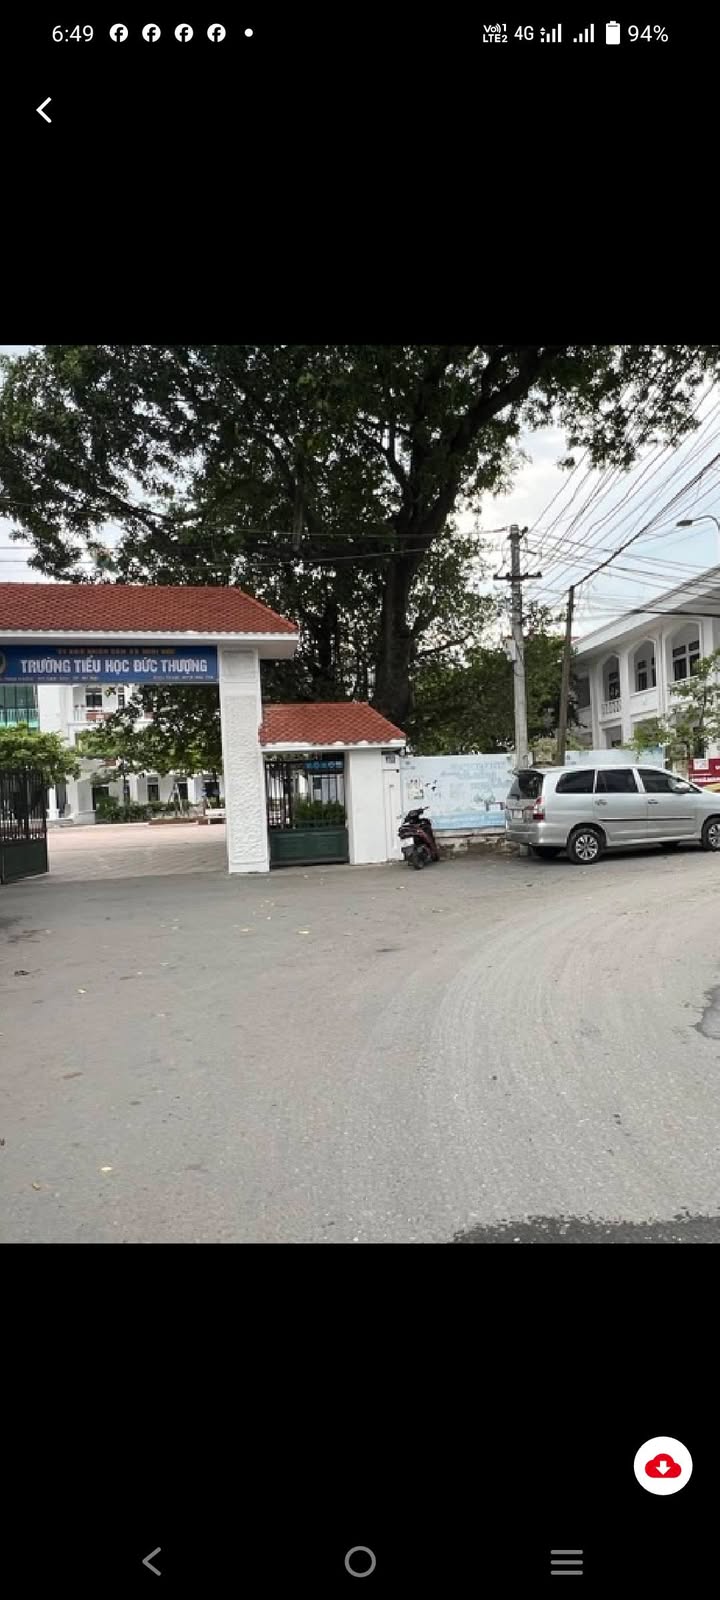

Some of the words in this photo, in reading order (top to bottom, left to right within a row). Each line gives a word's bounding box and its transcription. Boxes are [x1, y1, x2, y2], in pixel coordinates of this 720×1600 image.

[21, 657, 71, 674] TRƯỜNG
[105, 659, 130, 676] HỌC
[133, 657, 158, 673] ĐỨC
[160, 658, 208, 675] THƯỢNG
